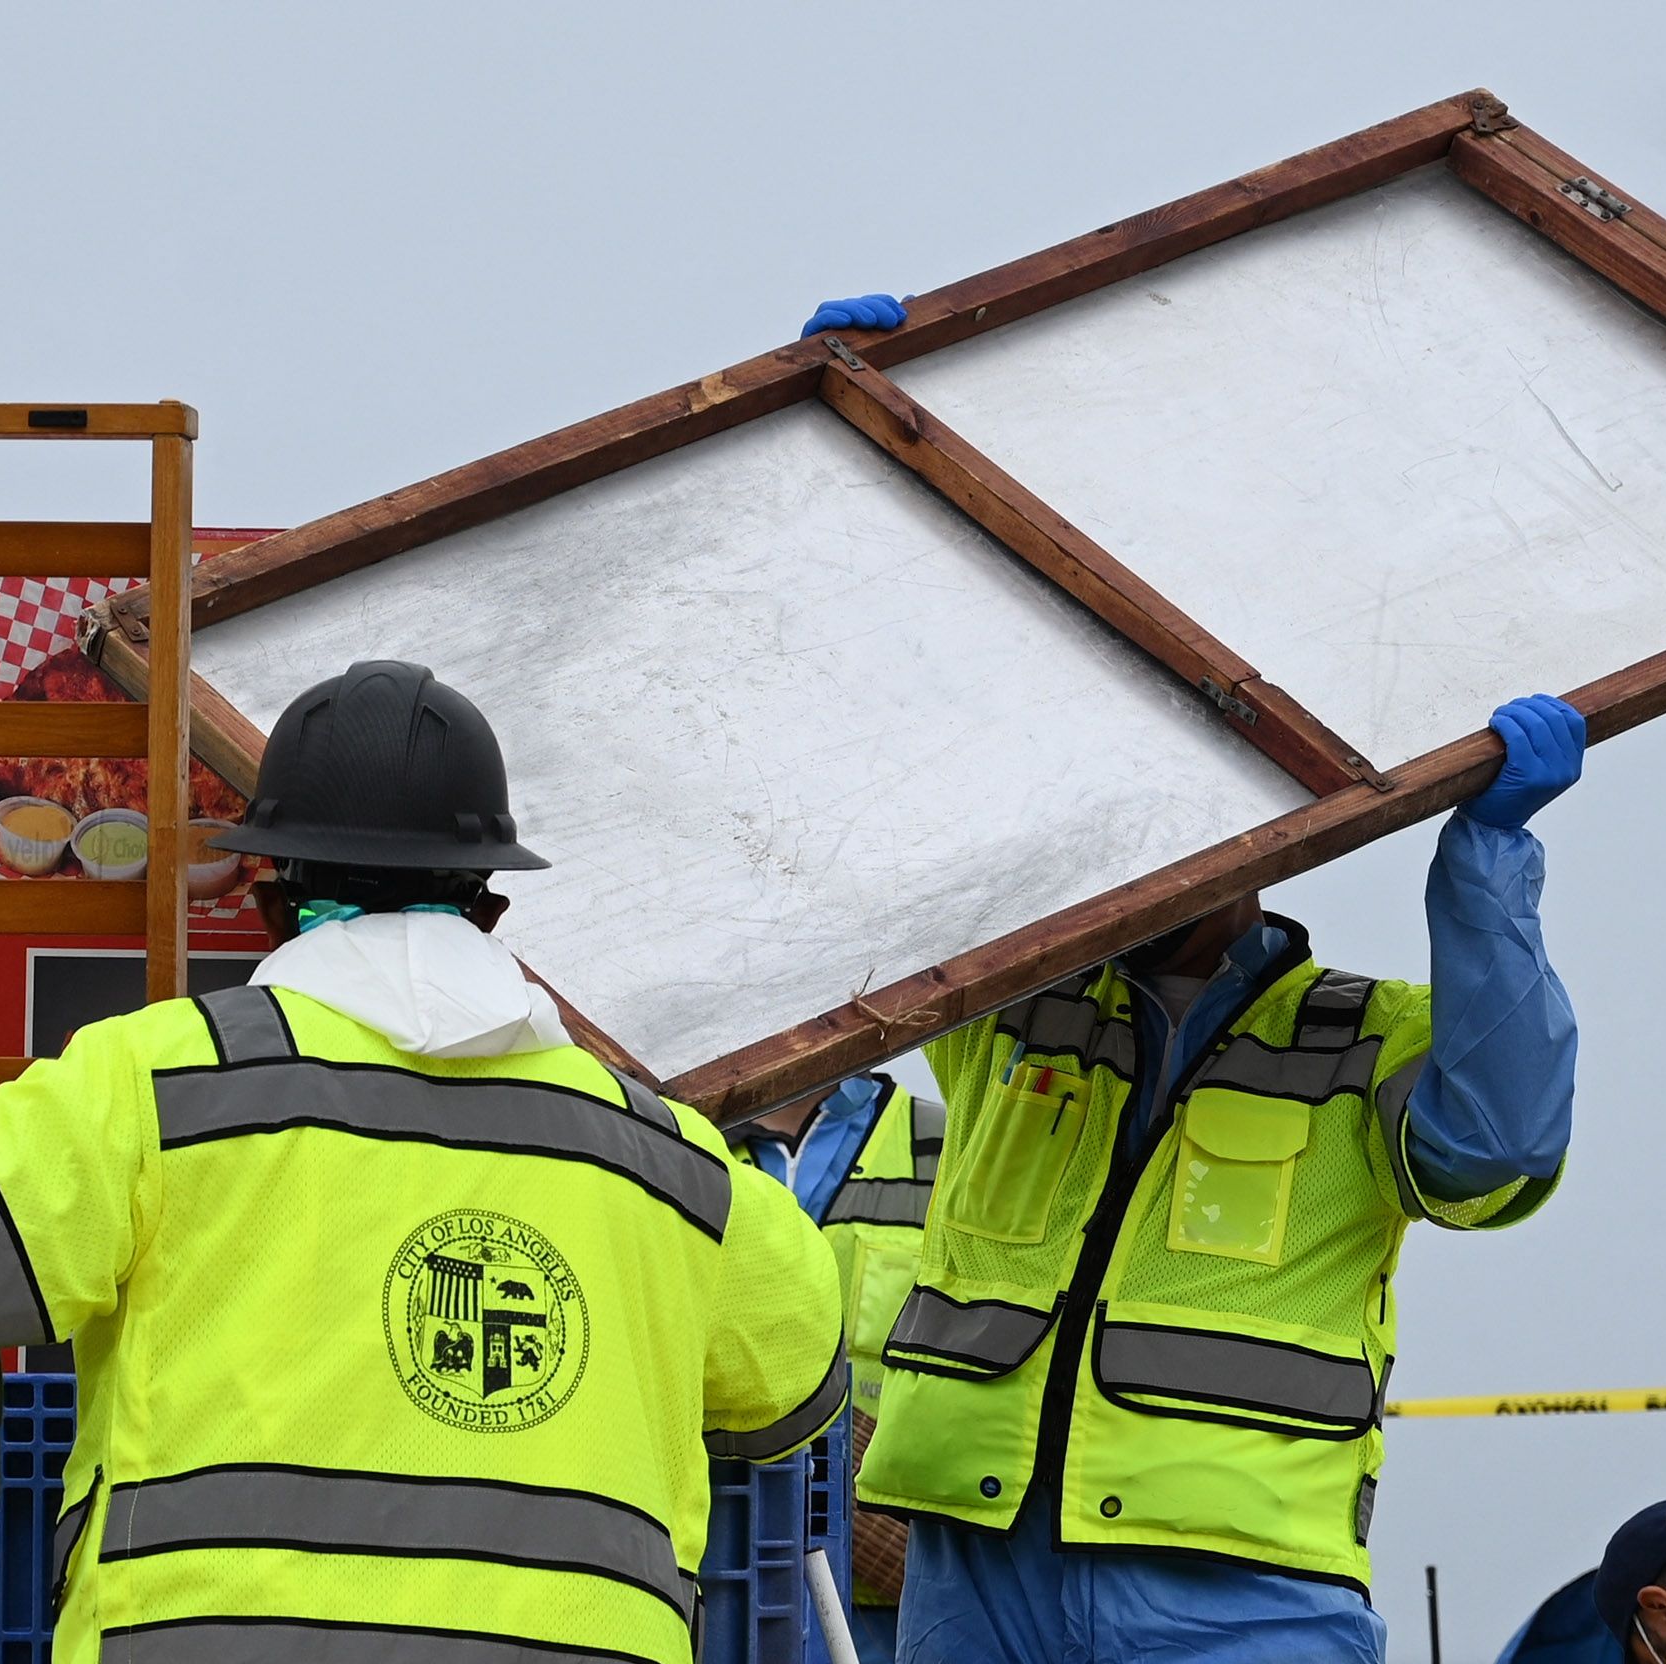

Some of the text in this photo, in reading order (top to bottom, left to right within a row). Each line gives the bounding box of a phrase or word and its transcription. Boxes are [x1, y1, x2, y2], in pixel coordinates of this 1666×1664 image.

[397, 1219, 576, 1302] CITY OF LOS ANGELES
[407, 1374, 557, 1426] FOUNDED 1781
